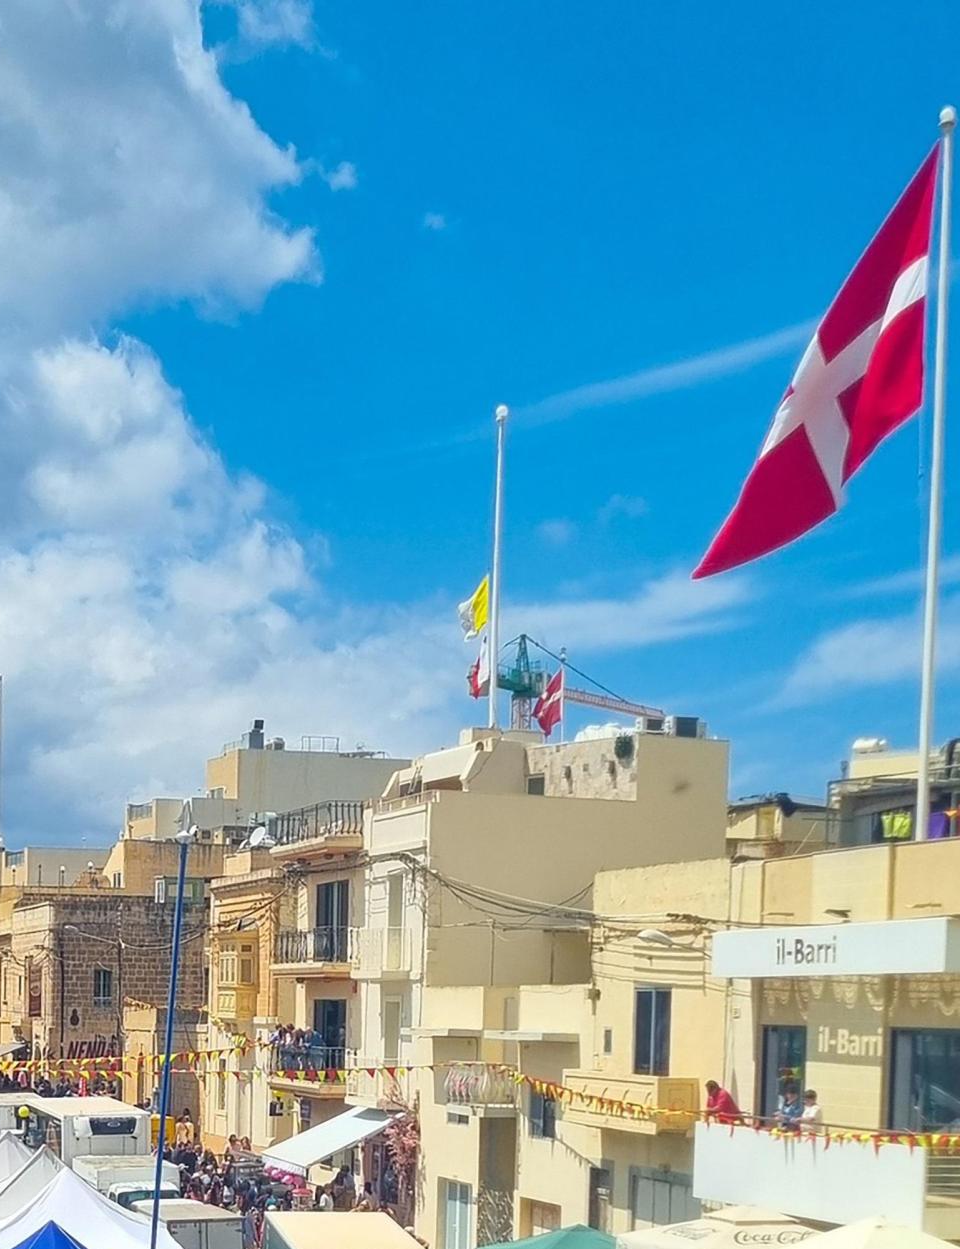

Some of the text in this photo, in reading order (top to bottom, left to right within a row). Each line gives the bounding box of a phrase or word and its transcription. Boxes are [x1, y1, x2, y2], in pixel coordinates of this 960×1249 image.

[776, 935, 837, 966] il-Barri
[817, 1025, 883, 1057] il-Barri
[733, 1230, 773, 1245] Coca
